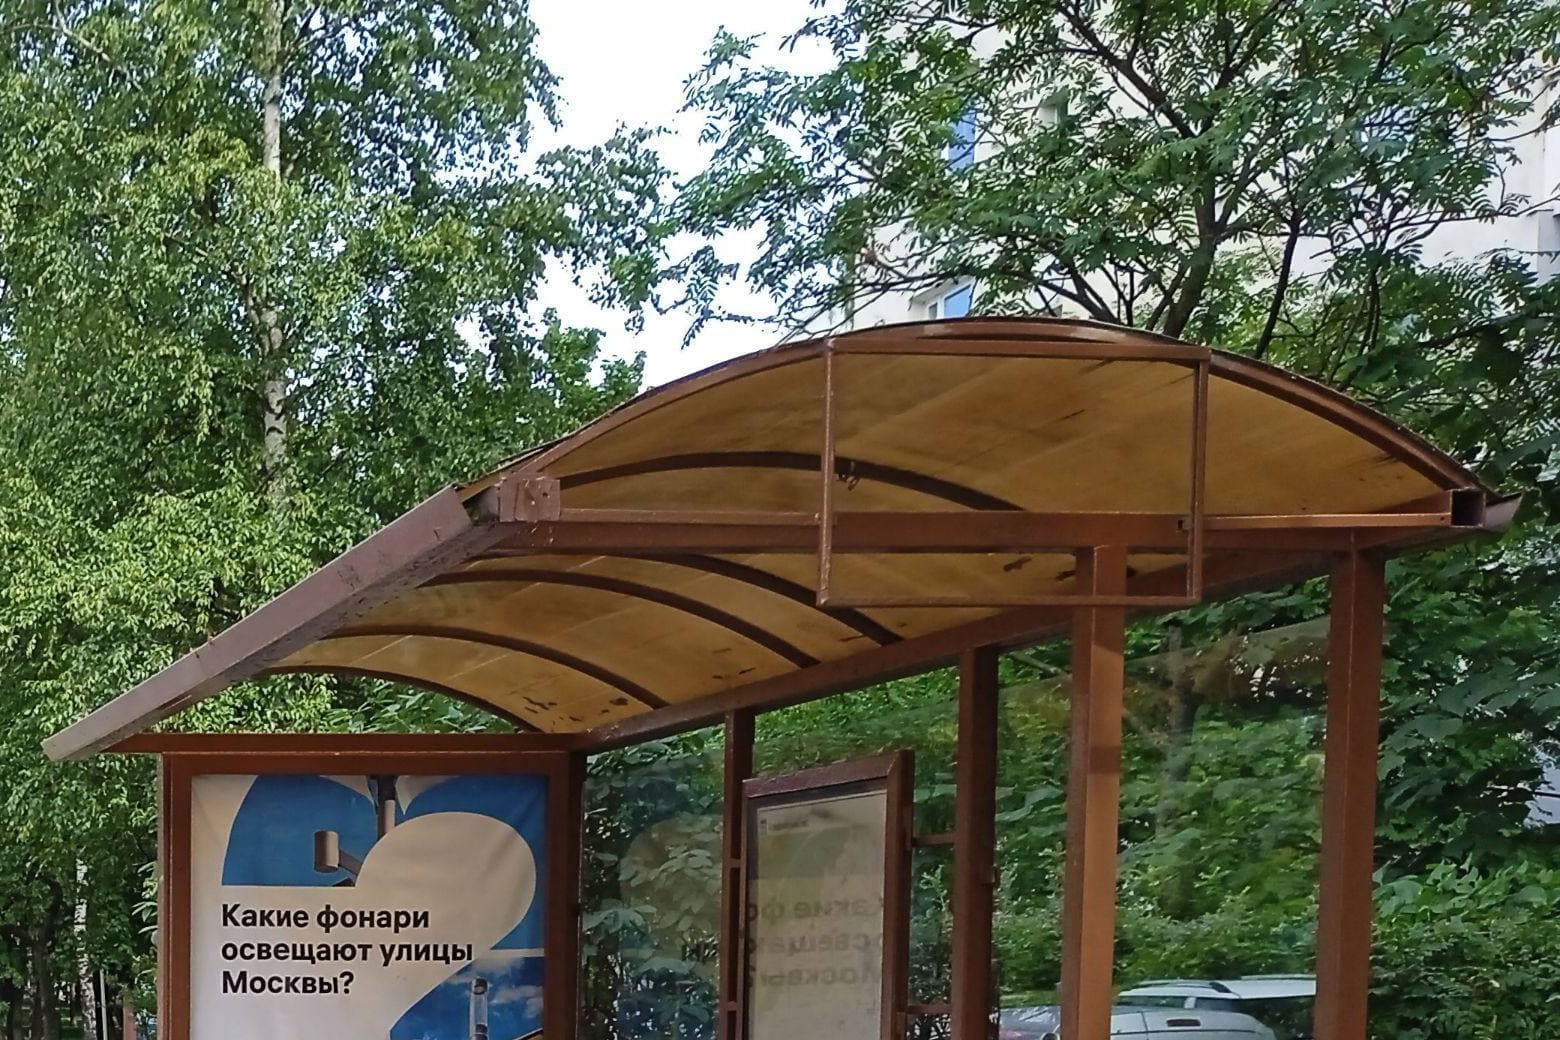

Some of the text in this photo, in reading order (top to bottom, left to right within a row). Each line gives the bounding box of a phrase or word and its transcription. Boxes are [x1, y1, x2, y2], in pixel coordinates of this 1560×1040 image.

[221, 903, 430, 934] Какие фонари
[221, 941, 473, 967] освещают улицы
[222, 970, 355, 995] Москвы?
